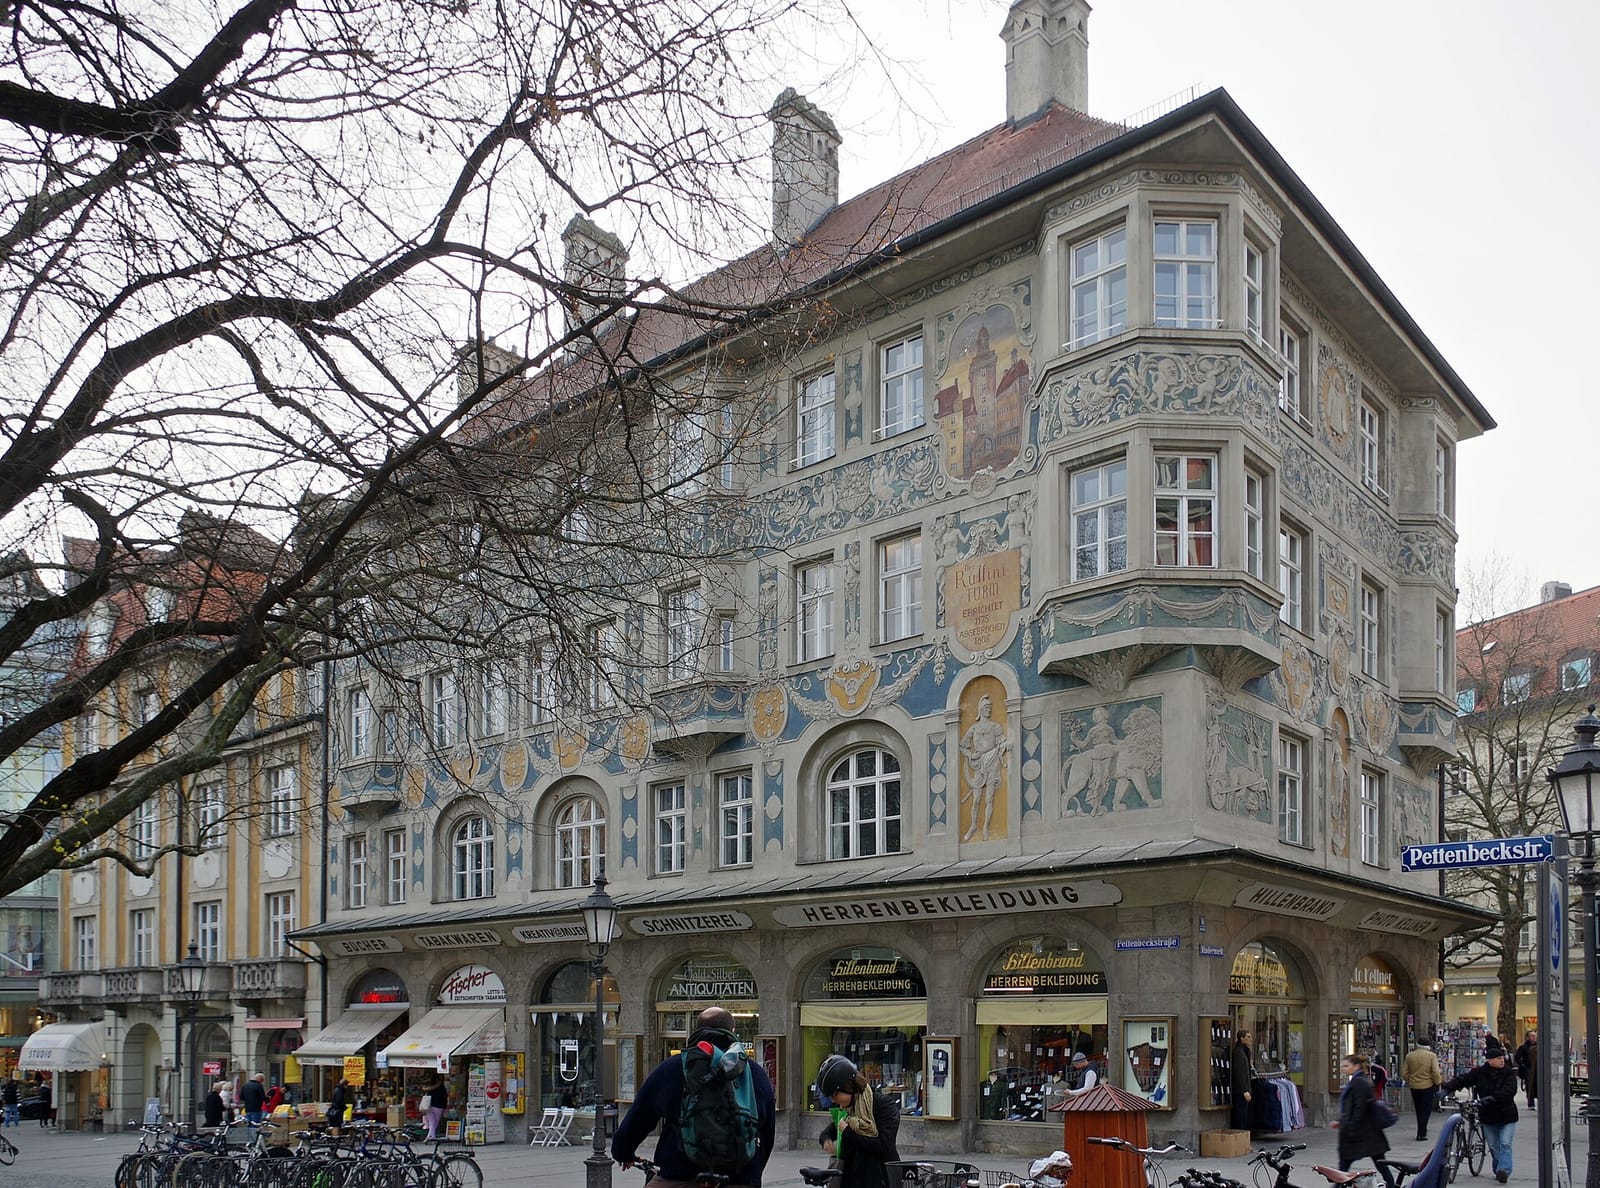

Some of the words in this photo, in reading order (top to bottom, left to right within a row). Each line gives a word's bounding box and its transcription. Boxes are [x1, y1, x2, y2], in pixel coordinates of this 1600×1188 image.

[962, 601, 1003, 618] ERRICHTET
[1409, 841, 1545, 866] Pettenbeckstr.
[802, 885, 1080, 922] HERRENBEKLEIDUNG
[1249, 887, 1336, 915] HILLENBRAND
[642, 913, 743, 932] SCHNITZEREI.
[1365, 911, 1398, 927] PHOTO
[1395, 916, 1432, 933] KELLNER
[418, 931, 498, 947] TABAKWAREN
[519, 925, 587, 940] KREATIV@MUEN
[342, 938, 391, 953] BÜCHER
[1116, 938, 1177, 949] Pettenbeckstraße
[440, 965, 496, 1000] Fischer
[822, 979, 911, 992] HERRENBEKLEIDUNG
[990, 974, 1099, 987] HERRENBEKLEIDUNG
[29, 1049, 52, 1059] STUDIO
